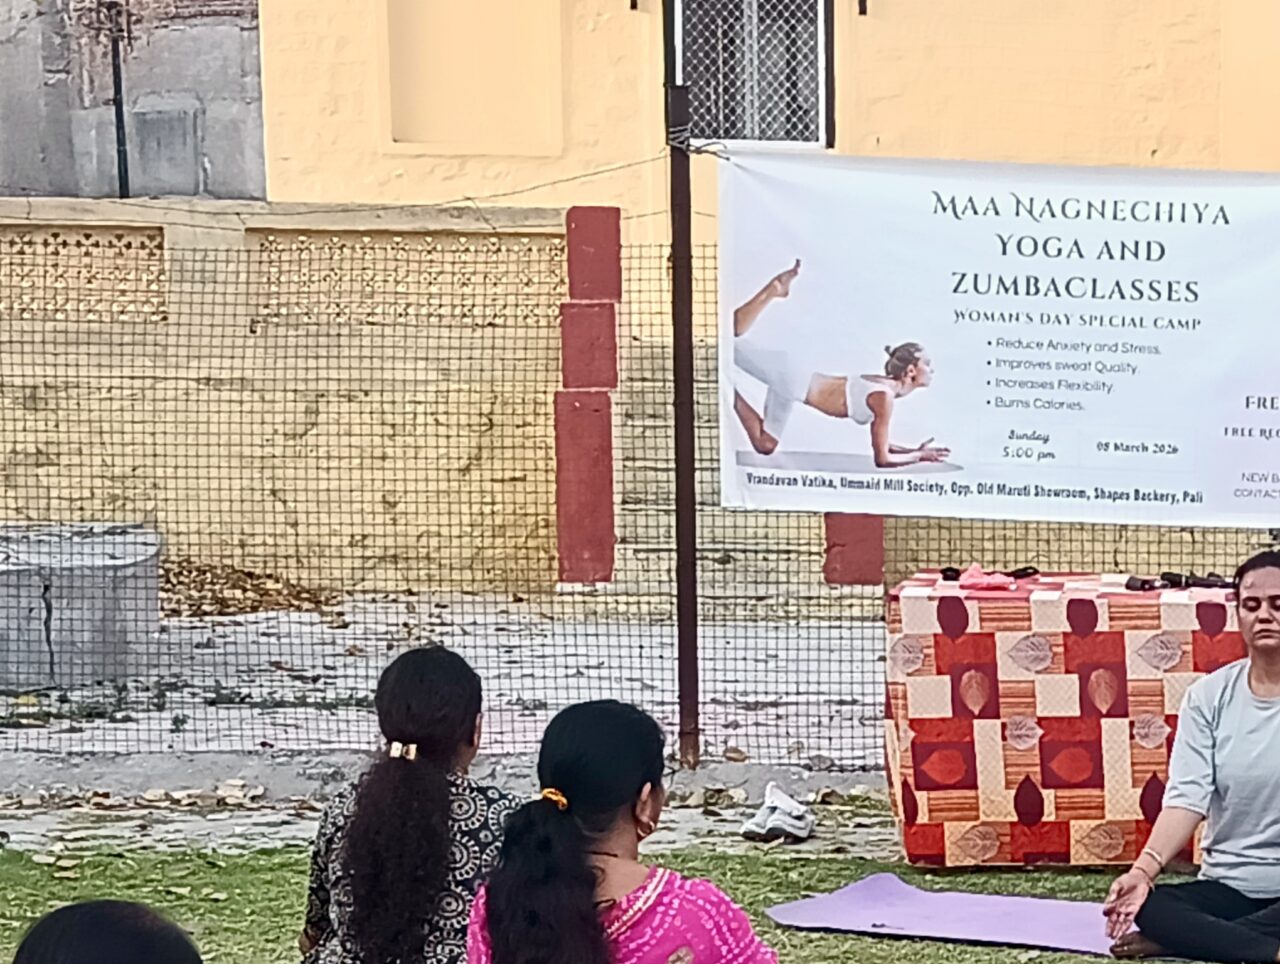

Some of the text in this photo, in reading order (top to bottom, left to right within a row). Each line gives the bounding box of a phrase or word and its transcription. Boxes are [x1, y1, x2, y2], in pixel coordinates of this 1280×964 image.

[931, 190, 1230, 225] MAA NAGNECHIYA
[995, 233, 1166, 262] YOGA AND
[952, 272, 1200, 303] ZUMBACLASSES
[954, 309, 1201, 331] WOMAN'S DAY SPECIAL CAMP
[995, 337, 1044, 350] Reduce
[1046, 340, 1092, 354] Anxiety
[1094, 342, 1118, 354] and
[995, 358, 1051, 371] Improves
[995, 377, 1055, 390] Increases
[995, 397, 1030, 408] Burns
[1008, 429, 1050, 444] Sunday
[1002, 446, 1056, 462] 5:00 pm
[1114, 442, 1149, 453] March
[884, 478, 903, 491] Mill
[977, 482, 994, 495] Old
[997, 483, 1030, 497] Maruti
[1183, 490, 1203, 504] Pali
